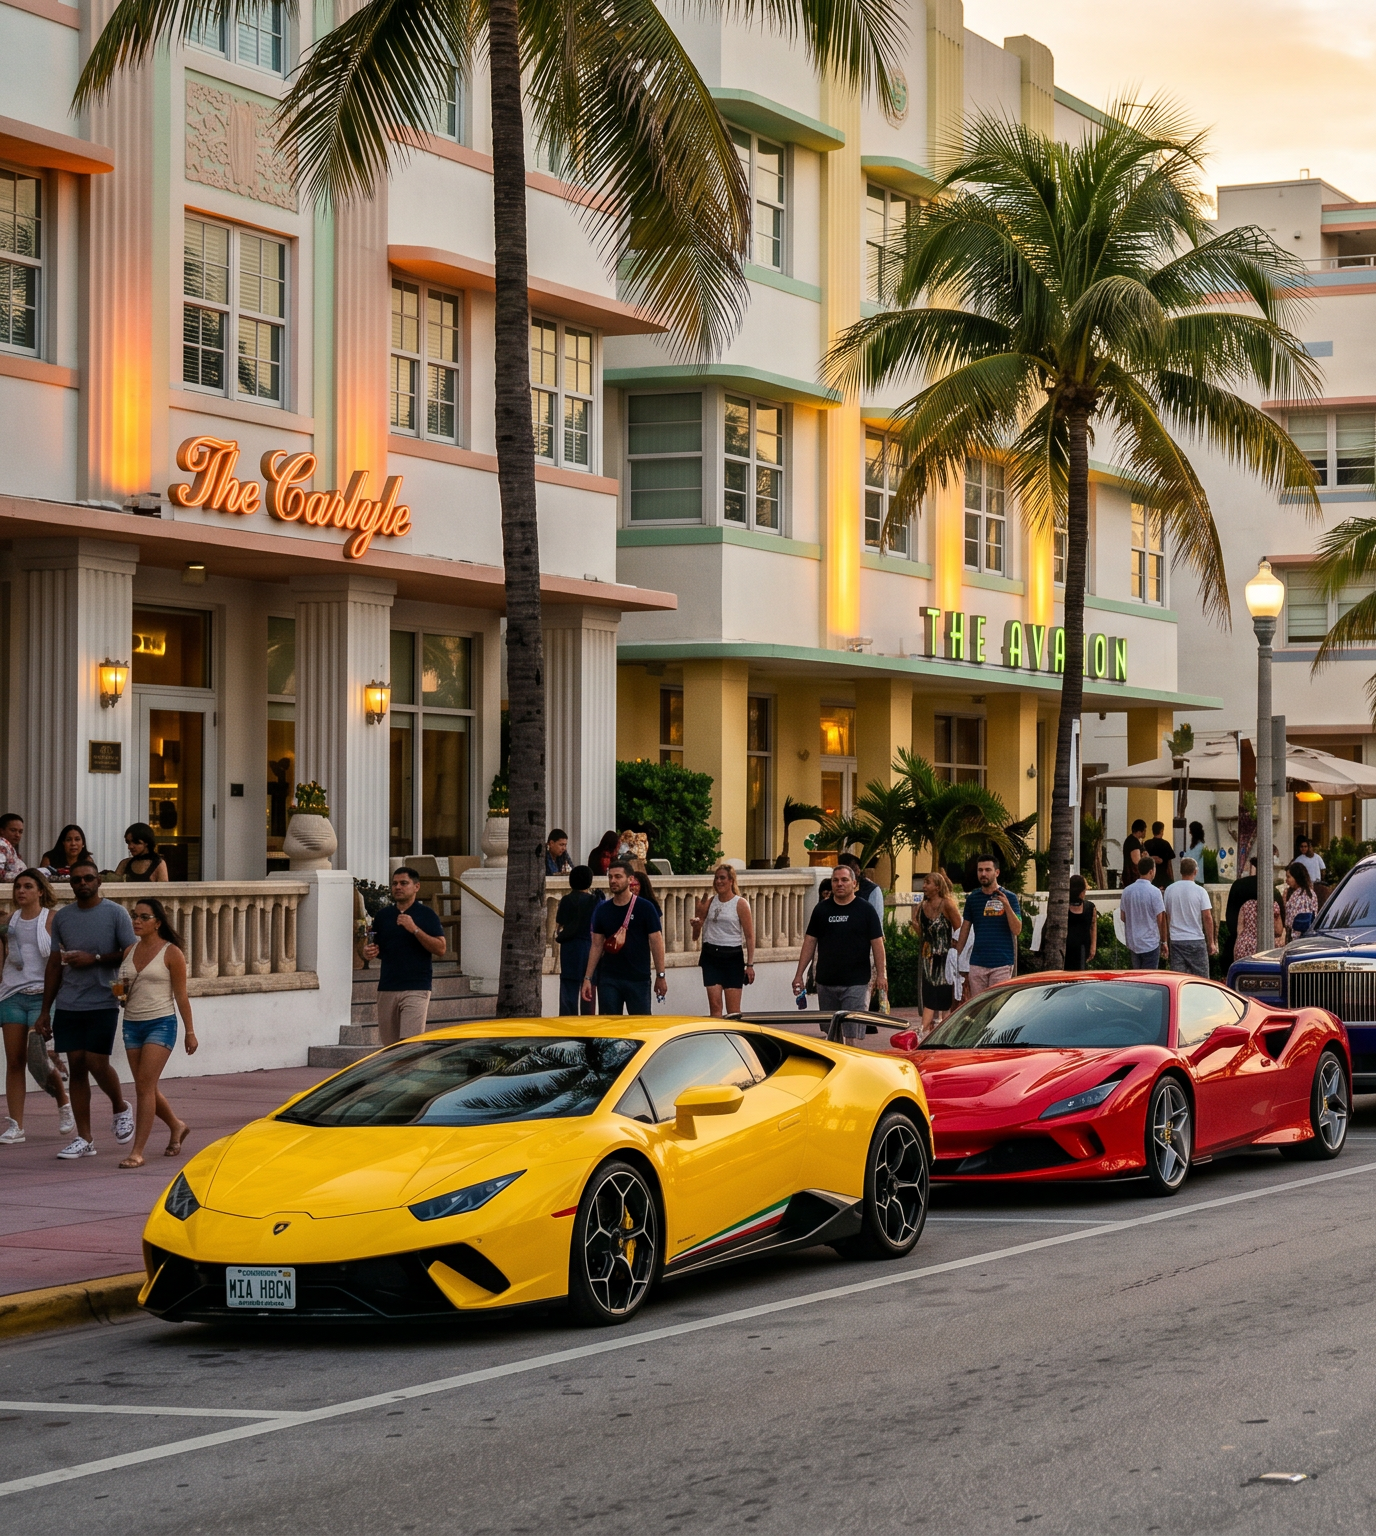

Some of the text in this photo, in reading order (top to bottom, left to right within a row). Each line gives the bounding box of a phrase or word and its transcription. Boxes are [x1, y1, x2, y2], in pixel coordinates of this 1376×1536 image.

[168, 436, 412, 559] The Carlyle
[919, 607, 1128, 682] THE AVAON
[229, 1279, 292, 1299] MIA HBCN
